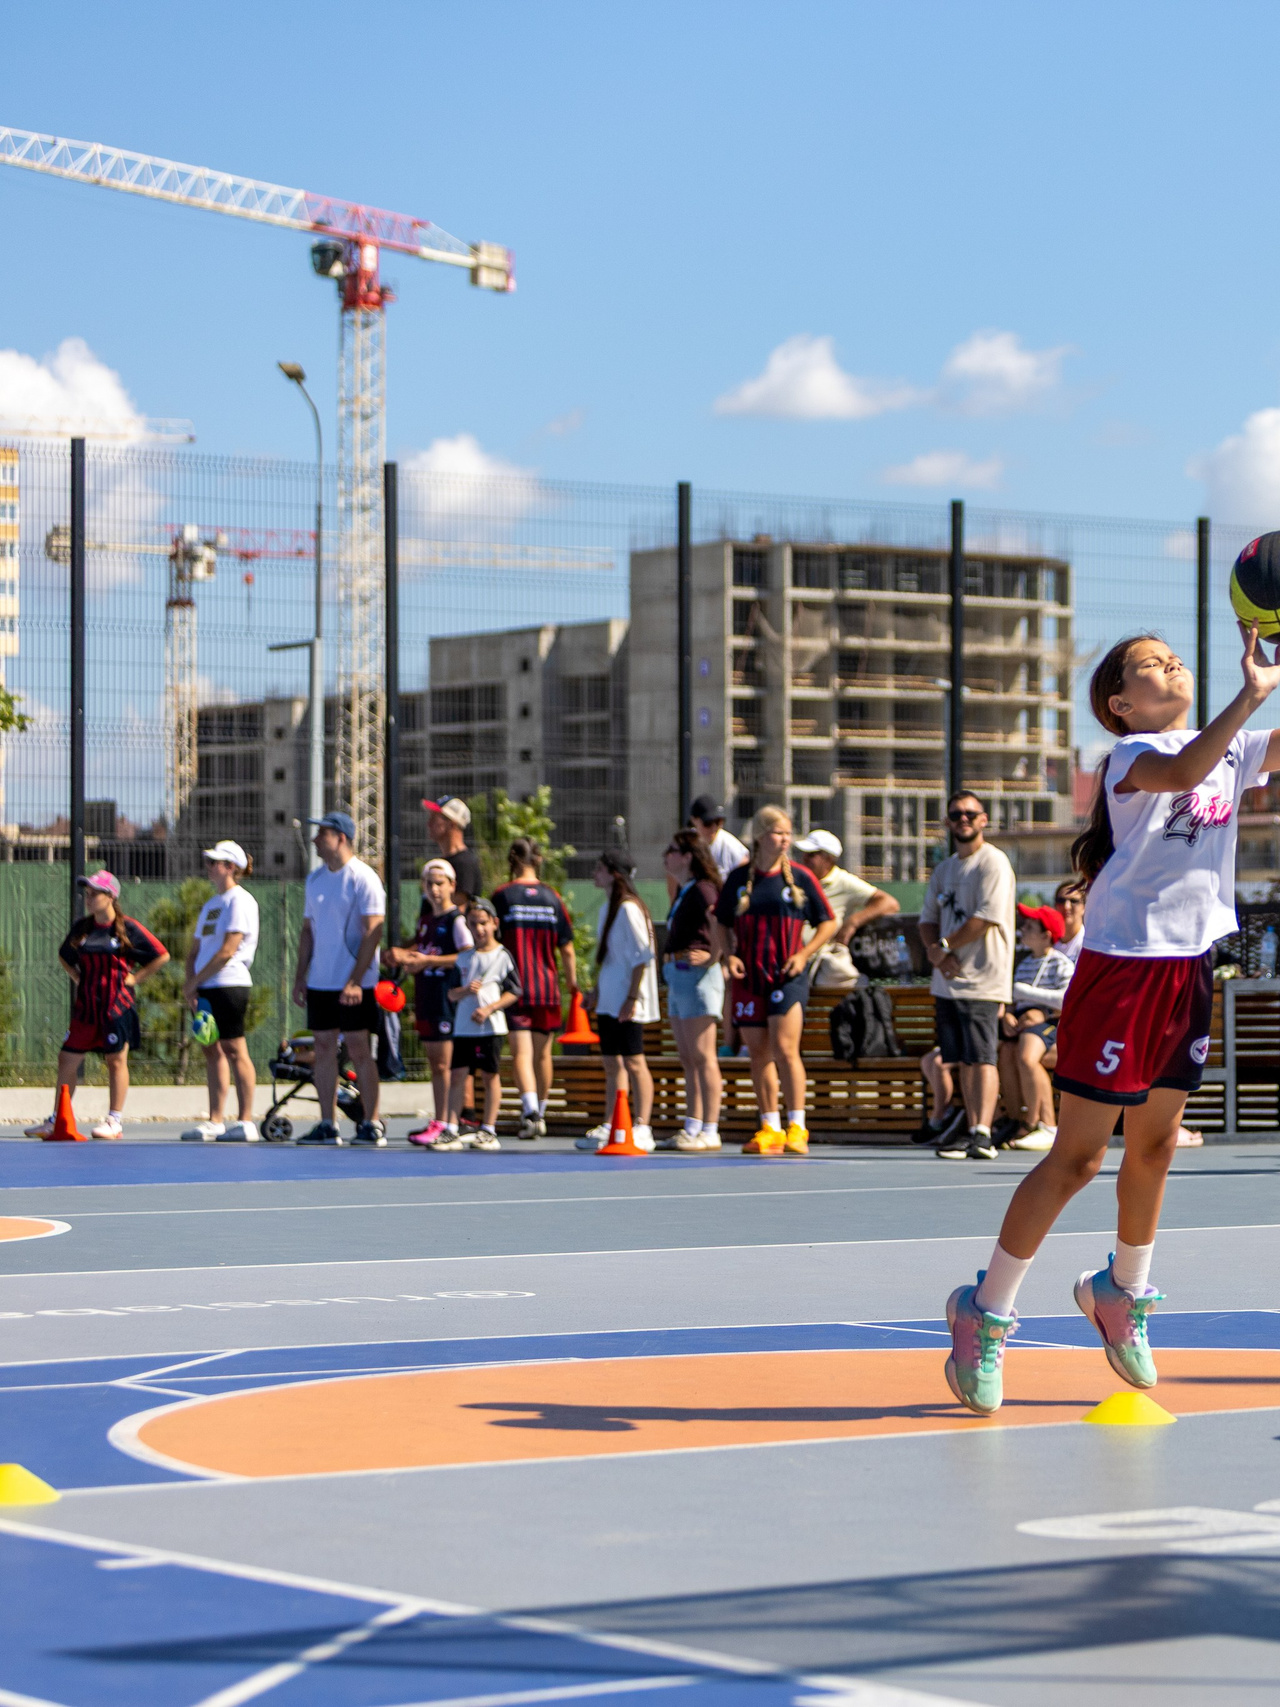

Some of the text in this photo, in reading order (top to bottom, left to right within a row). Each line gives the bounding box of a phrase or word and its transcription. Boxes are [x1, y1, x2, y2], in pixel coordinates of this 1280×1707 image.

[1163, 791, 1233, 847] Руби
[735, 1000, 755, 1018] 34
[1095, 1039, 1126, 1075] 5
